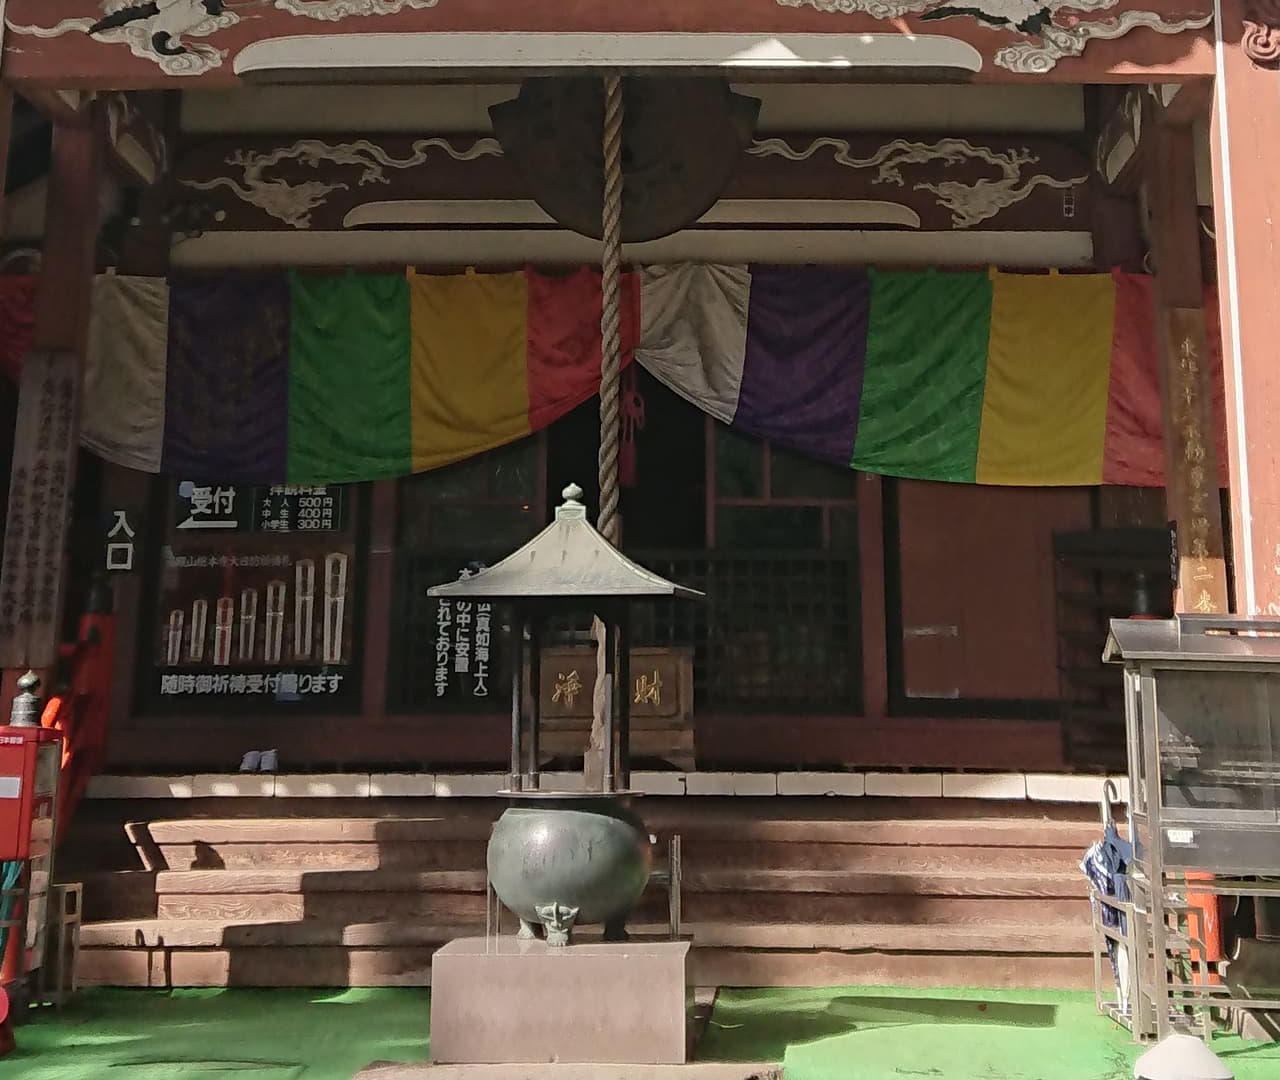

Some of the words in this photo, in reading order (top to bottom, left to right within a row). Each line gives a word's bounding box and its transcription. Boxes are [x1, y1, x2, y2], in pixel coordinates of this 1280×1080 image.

[190, 486, 236, 515] 受付
[298, 497, 333, 508] 500円
[297, 508, 333, 519] 400円
[261, 520, 289, 530] 小学生
[296, 520, 332, 530] 300円
[106, 510, 136, 570] 入口
